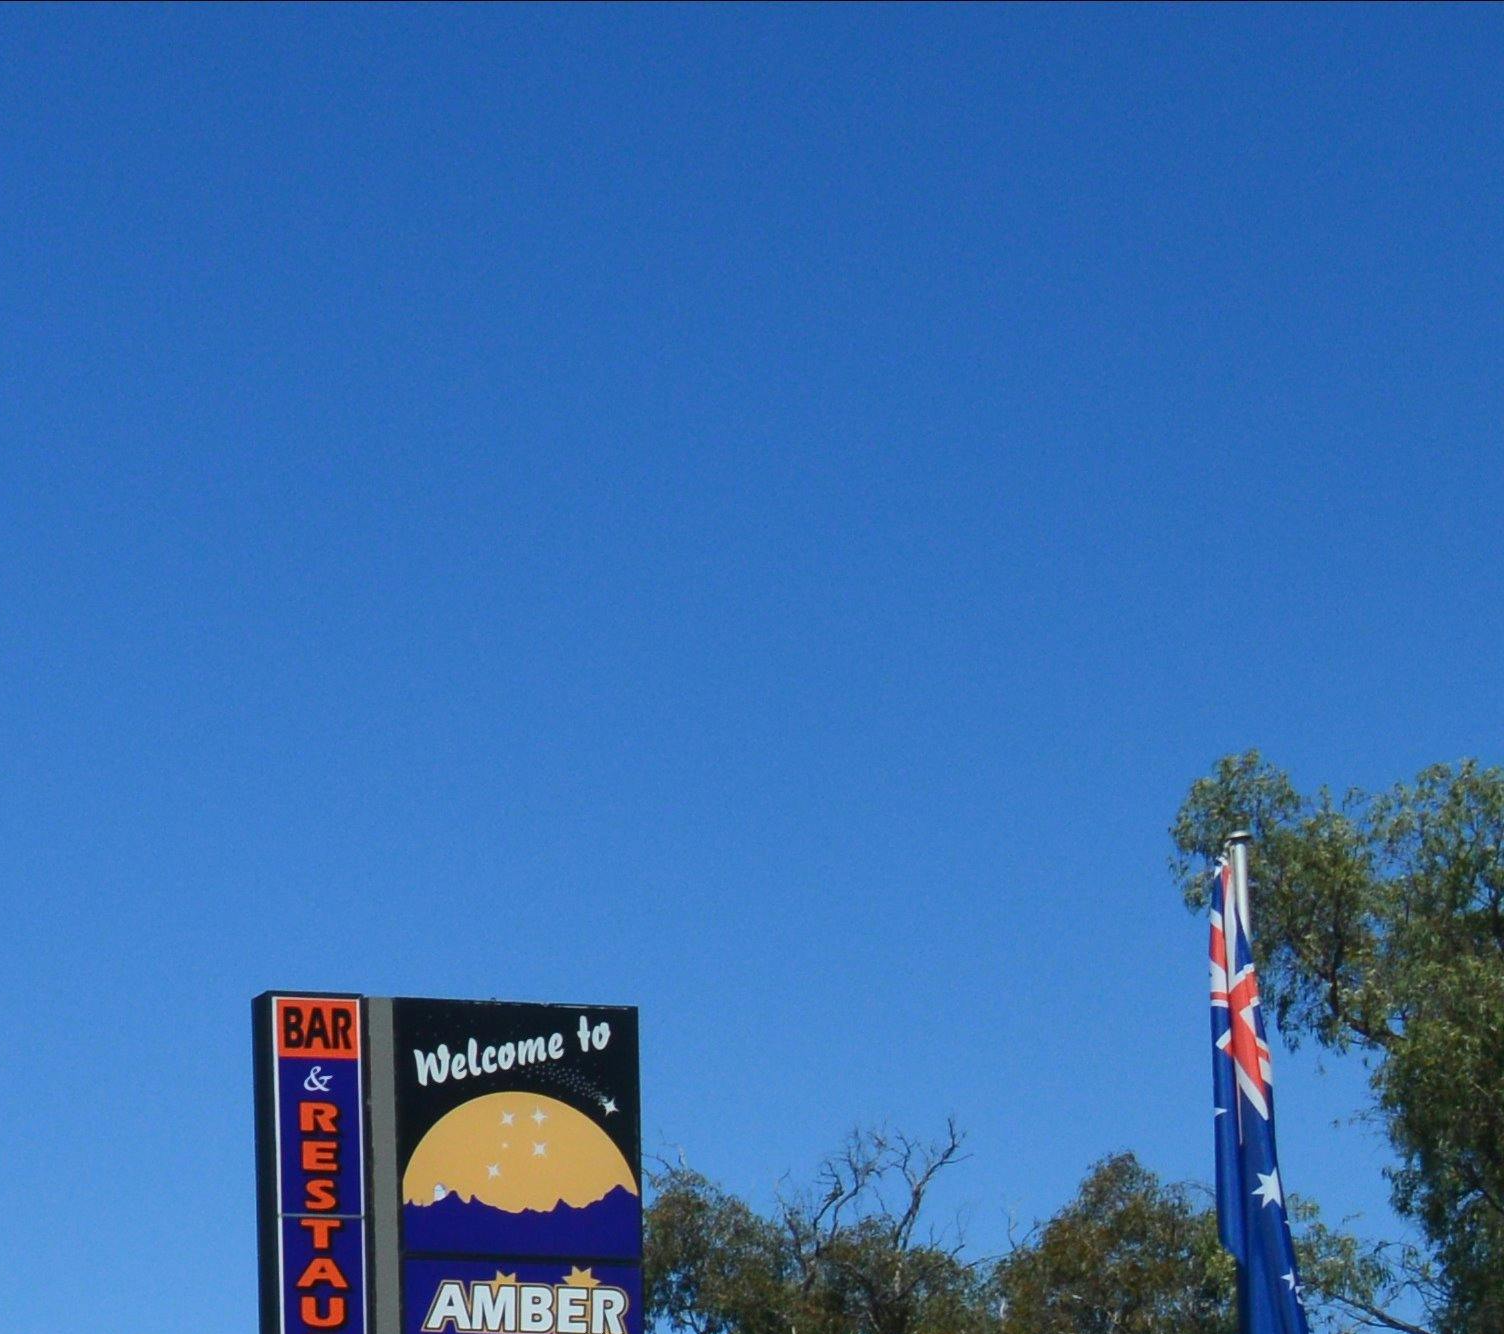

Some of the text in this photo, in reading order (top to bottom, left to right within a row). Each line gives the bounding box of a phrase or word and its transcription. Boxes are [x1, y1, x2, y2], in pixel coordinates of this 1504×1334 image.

[283, 1006, 352, 1050] BAR
[413, 1015, 611, 1087] Welcome to
[303, 1066, 333, 1092] &
